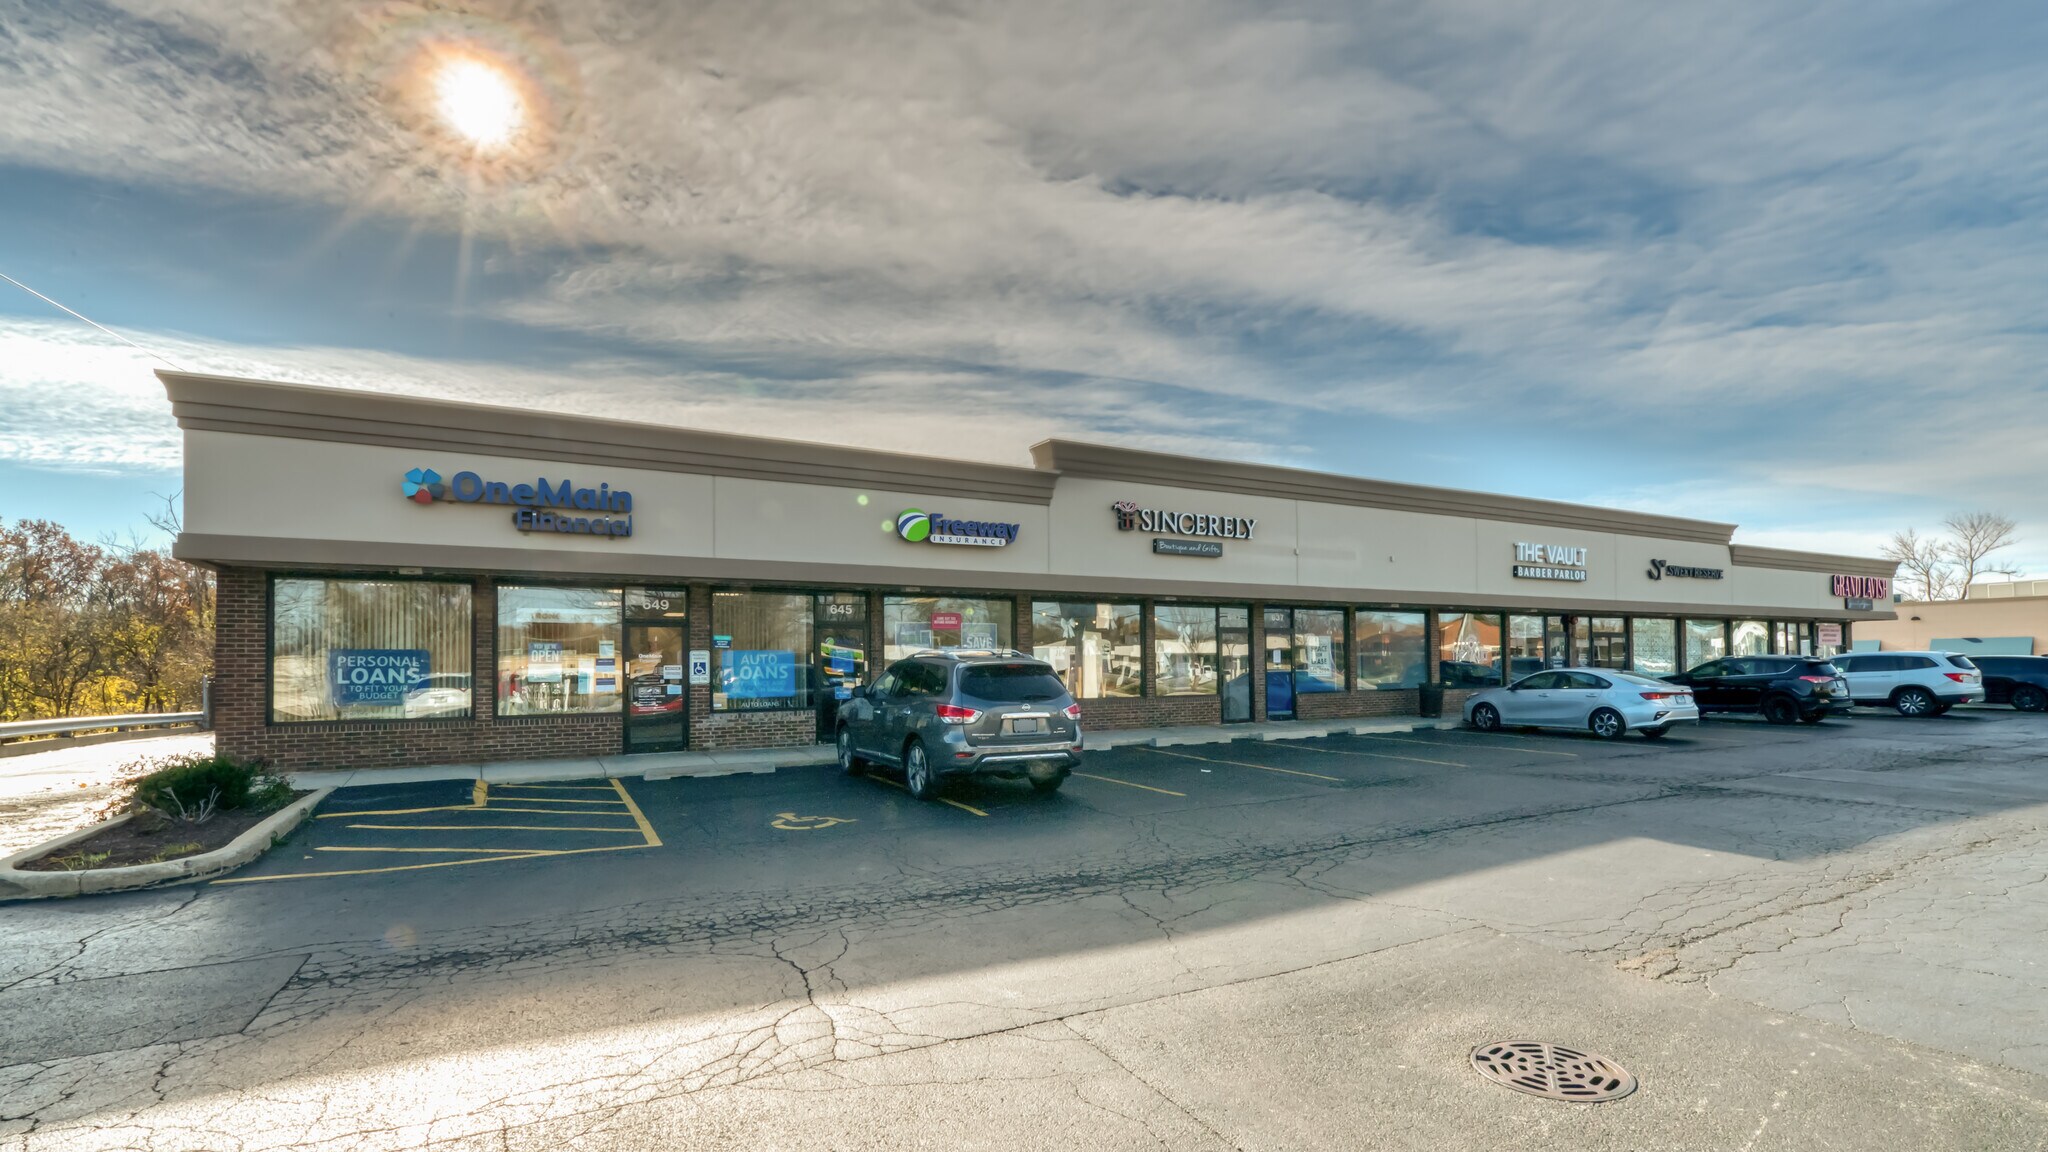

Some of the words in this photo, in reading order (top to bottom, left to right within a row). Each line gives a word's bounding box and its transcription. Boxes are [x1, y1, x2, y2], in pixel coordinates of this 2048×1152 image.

[452, 471, 633, 513] OneMain
[516, 508, 633, 537] Financial
[930, 513, 1020, 544] Freeway
[1141, 508, 1258, 539] SINCERELY
[933, 535, 1003, 546] INSURANCE
[1515, 542, 1544, 563] THE
[1547, 544, 1587, 566] VAULT
[1518, 566, 1552, 578] BARBER
[1554, 569, 1586, 580] PARLOR
[1666, 565, 1693, 577] SWEET
[1694, 567, 1723, 580] RESERVE
[1833, 574, 1861, 597] GRAND
[1863, 576, 1887, 599] LAVISH
[642, 599, 670, 610] 649
[830, 604, 853, 614] 645
[966, 635, 993, 649] SAVE
[337, 656, 421, 667] PERSONAL
[532, 650, 559, 662] OPEN
[740, 654, 778, 665] AUTO
[337, 667, 421, 684] LOANS
[733, 665, 789, 680] OANS
